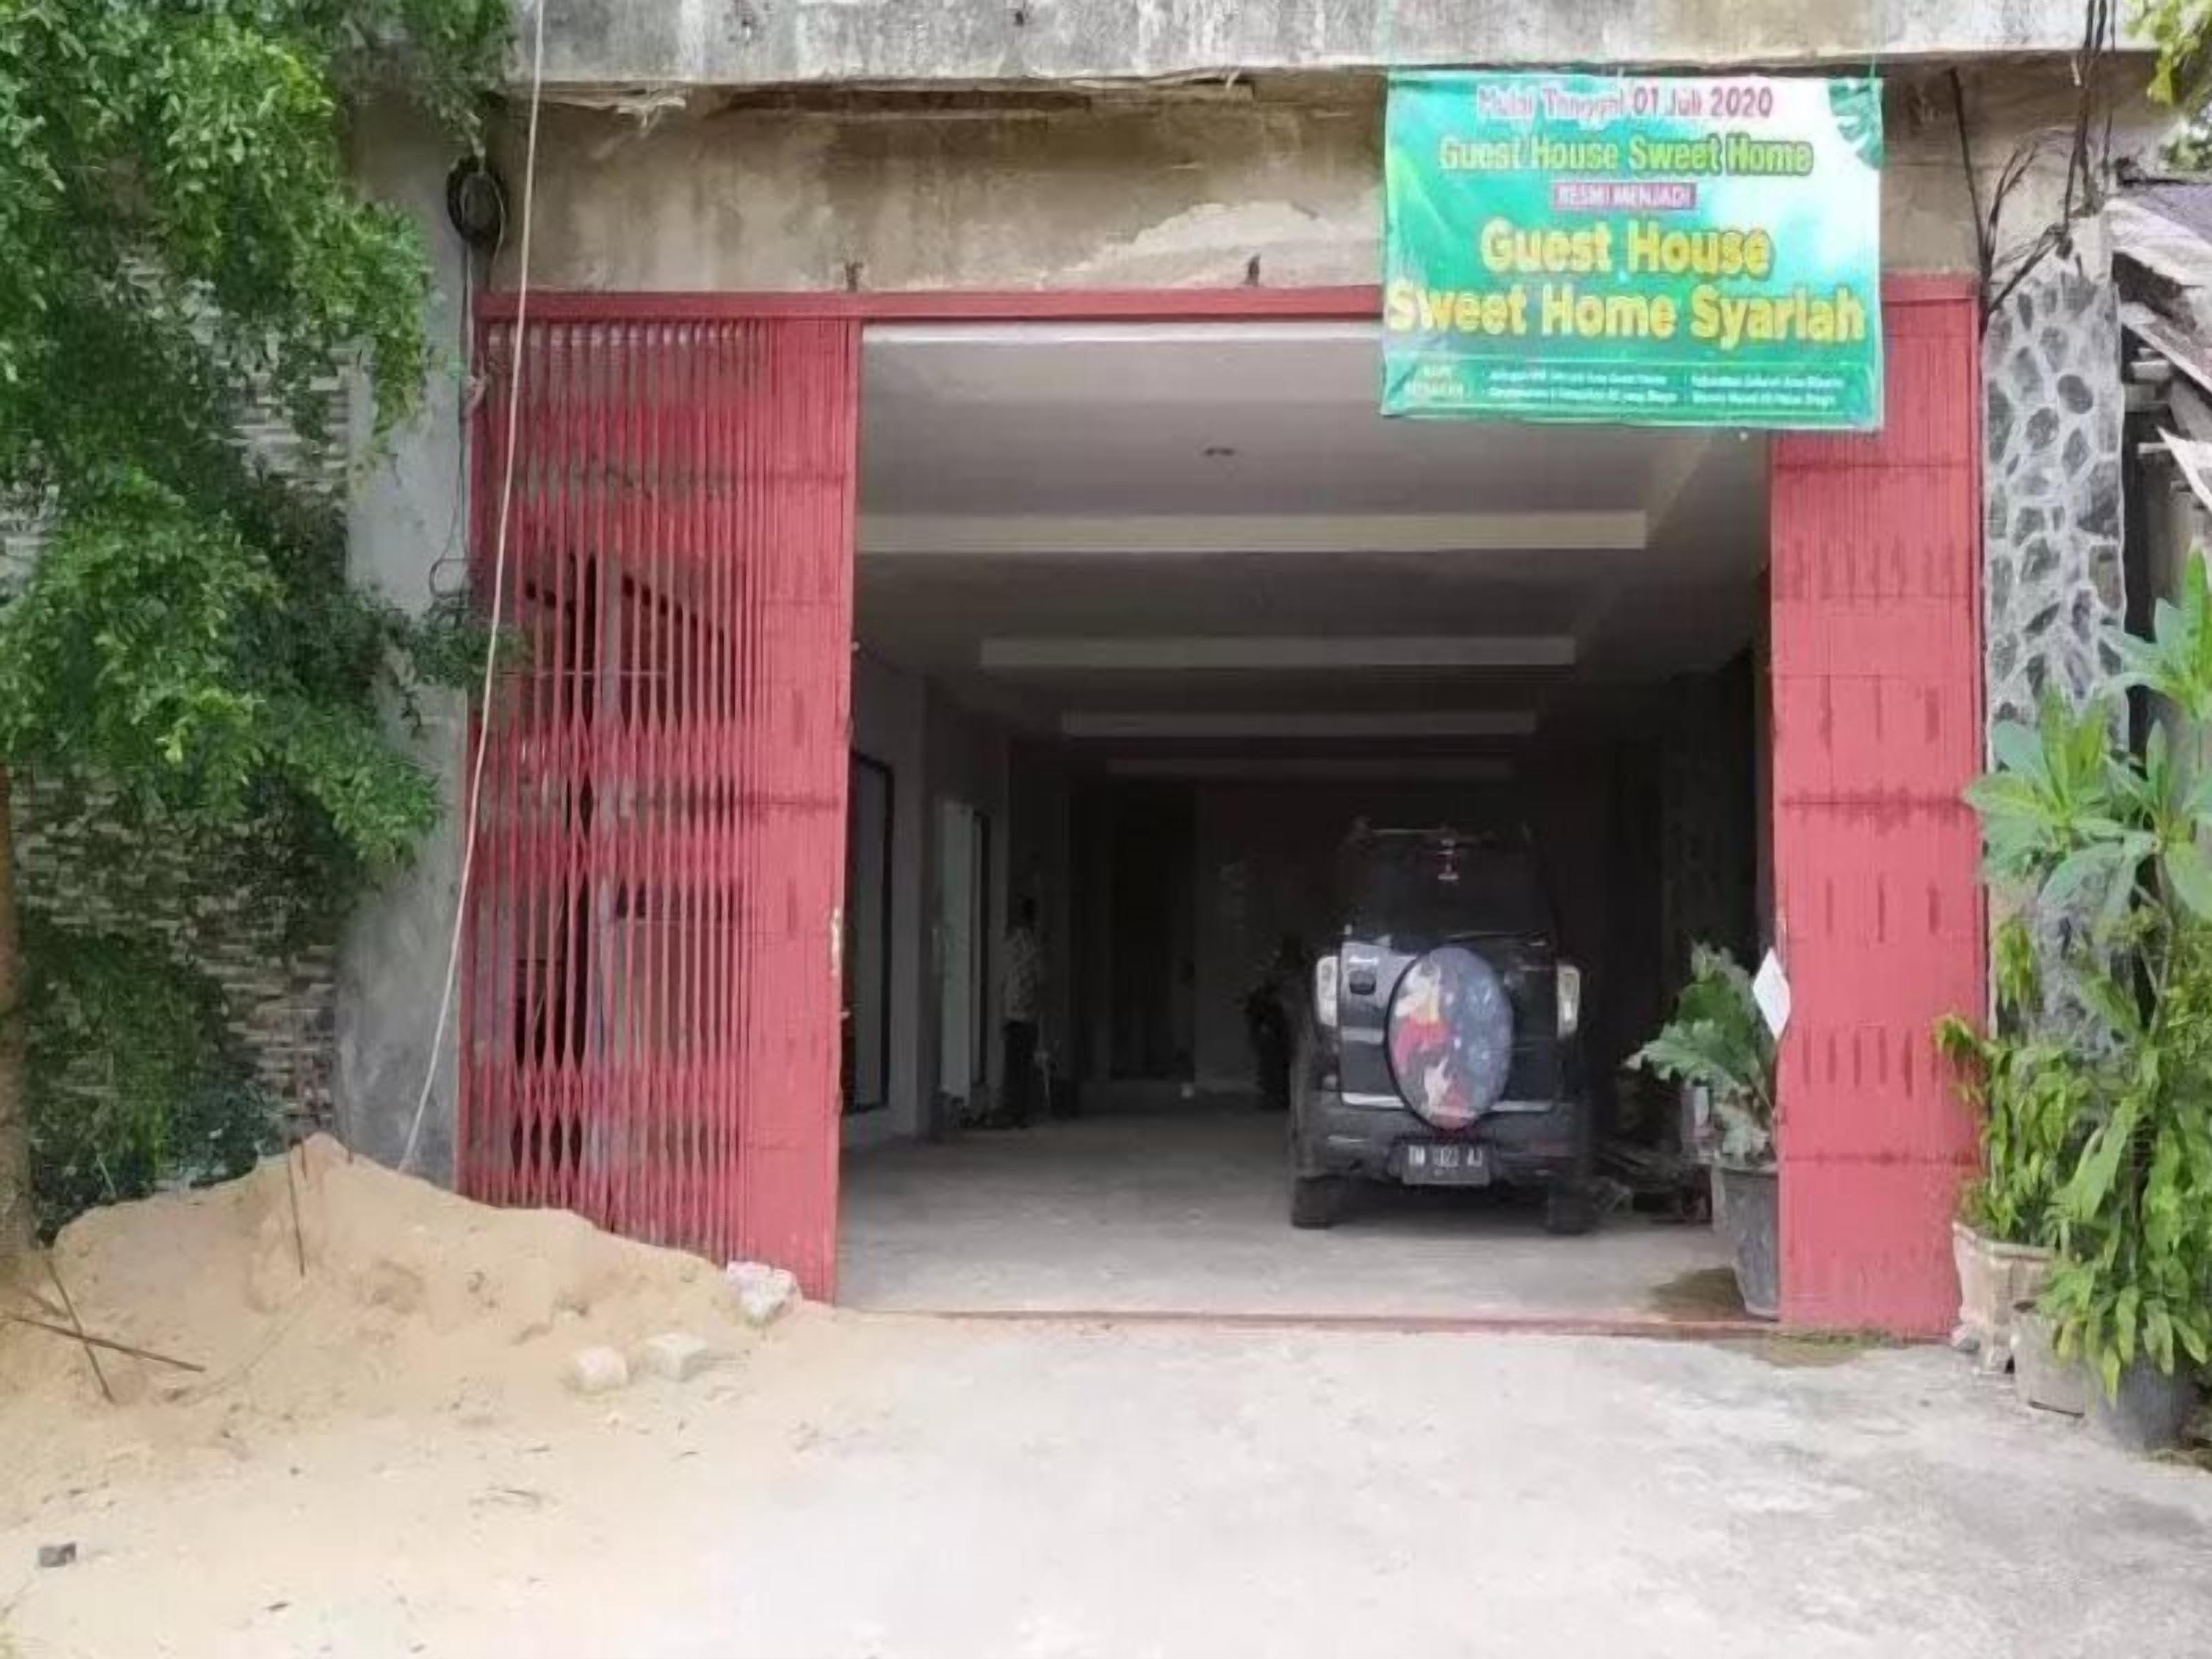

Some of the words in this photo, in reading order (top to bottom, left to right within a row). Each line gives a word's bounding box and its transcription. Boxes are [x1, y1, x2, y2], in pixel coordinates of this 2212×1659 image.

[1633, 87, 1658, 116] 01
[1665, 87, 1703, 116] Juli
[1711, 86, 1774, 118] 2020
[1441, 138, 1521, 170] Guest
[1532, 137, 1618, 171] House
[1629, 135, 1721, 174] Sweet
[1727, 135, 1812, 174] Home
[1480, 218, 1613, 272] Guest
[1628, 221, 1770, 274] House
[1385, 281, 1527, 335] Sweet
[1541, 283, 1675, 338] Home
[1691, 284, 1864, 350] Syariah
